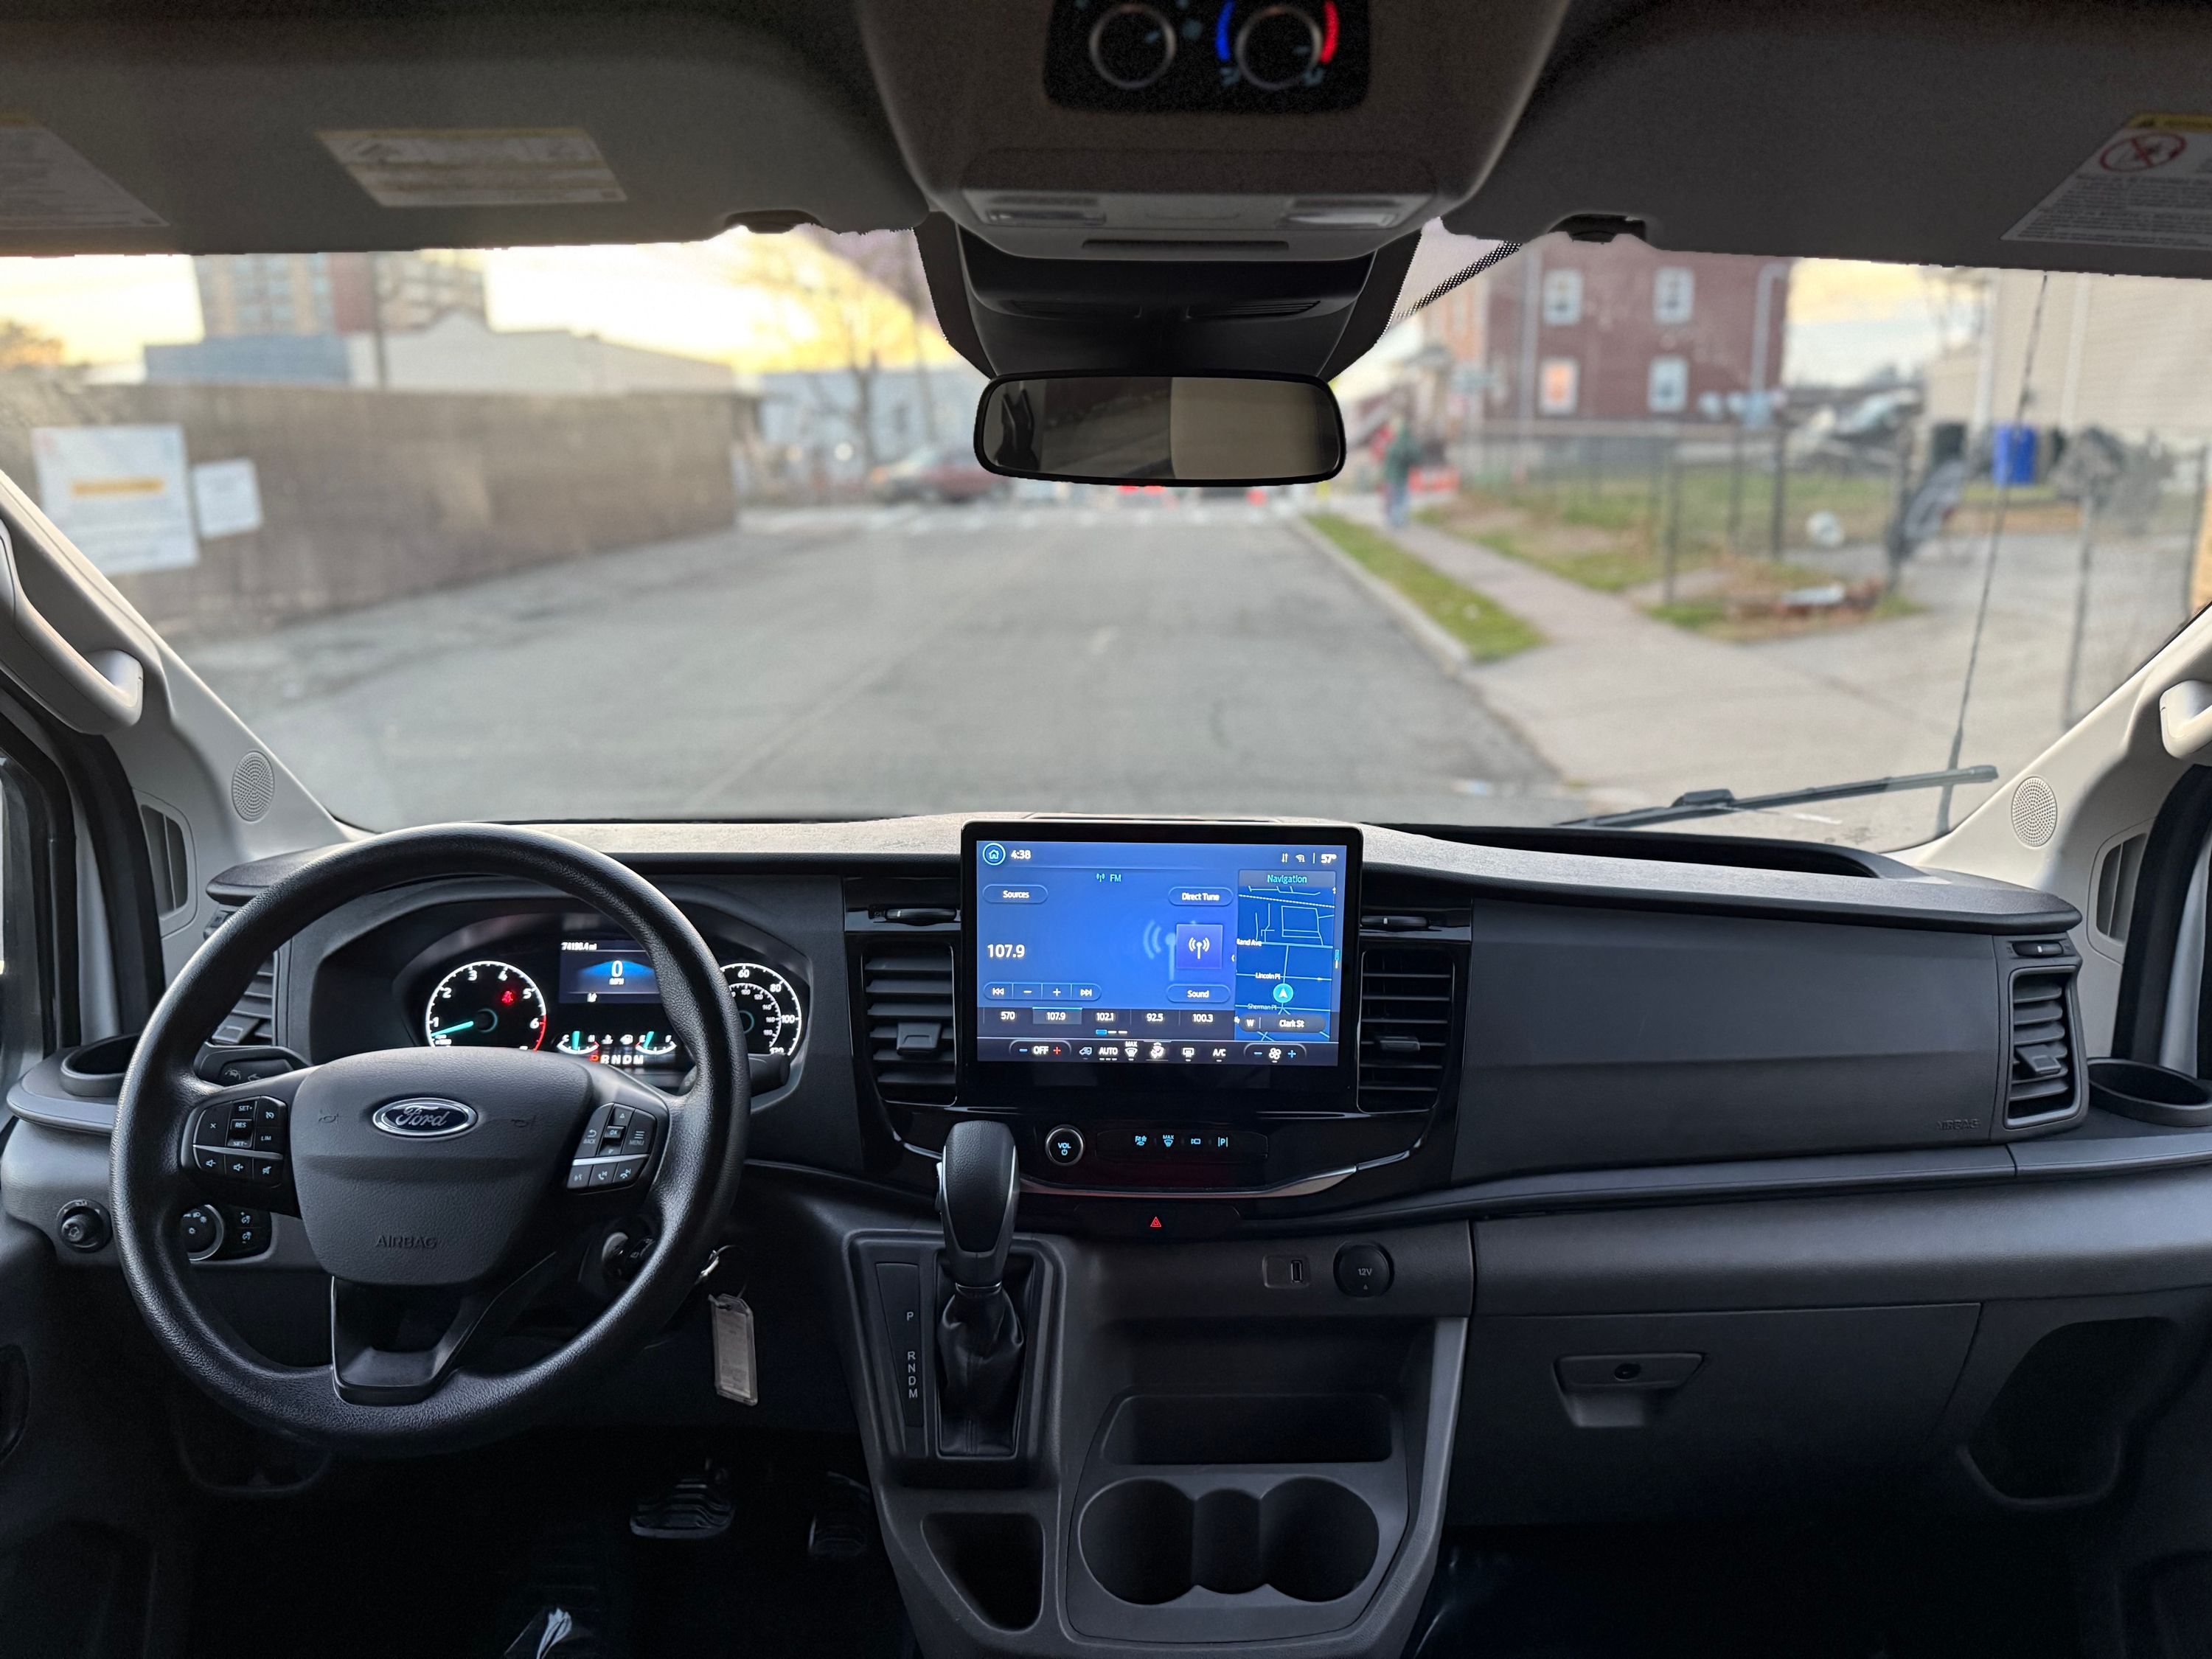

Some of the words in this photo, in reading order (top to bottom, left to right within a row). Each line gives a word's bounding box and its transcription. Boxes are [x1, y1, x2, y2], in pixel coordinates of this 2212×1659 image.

[1010, 850, 1032, 859] 4:38
[1110, 874, 1121, 882] FM
[1267, 874, 1307, 884] Navigation
[1003, 890, 1029, 899] Sources
[1181, 892, 1201, 900] Direct
[1203, 893, 1220, 901] Tune
[987, 944, 1026, 958] 107.9
[611, 960, 623, 978] 0
[737, 969, 750, 978] 60
[467, 970, 478, 981] 3
[498, 970, 507, 981] 4
[442, 987, 452, 998] 2
[770, 984, 782, 992] 80
[522, 988, 532, 999] 5
[1187, 990, 1210, 998] Sound
[782, 1015, 796, 1023] 100
[1001, 1011, 1015, 1020] 570
[1046, 1012, 1066, 1020] 107.9
[1096, 1012, 1114, 1021] 102.1
[1146, 1012, 1164, 1022] 92.5
[1192, 1013, 1214, 1023] 100.3
[432, 1017, 439, 1027] 1
[529, 1018, 539, 1029] 6
[1279, 1019, 1295, 1027] Clark
[1295, 1020, 1305, 1028] St
[1033, 1046, 1049, 1055] OFF
[1099, 1047, 1118, 1055] AUTO
[1212, 1048, 1226, 1057] A/C
[600, 1054, 610, 1064] R
[611, 1054, 621, 1064] N
[622, 1054, 632, 1064] D
[633, 1054, 644, 1064] M
[395, 1105, 451, 1127] Ford
[1937, 1118, 1980, 1130] AIRBAG
[375, 1234, 437, 1248] AIRBAG
[1357, 1267, 1372, 1276] 12V
[906, 1311, 914, 1321] P
[907, 1351, 916, 1360] R
[908, 1363, 916, 1373] N
[908, 1375, 917, 1385] D
[908, 1388, 918, 1398] M
